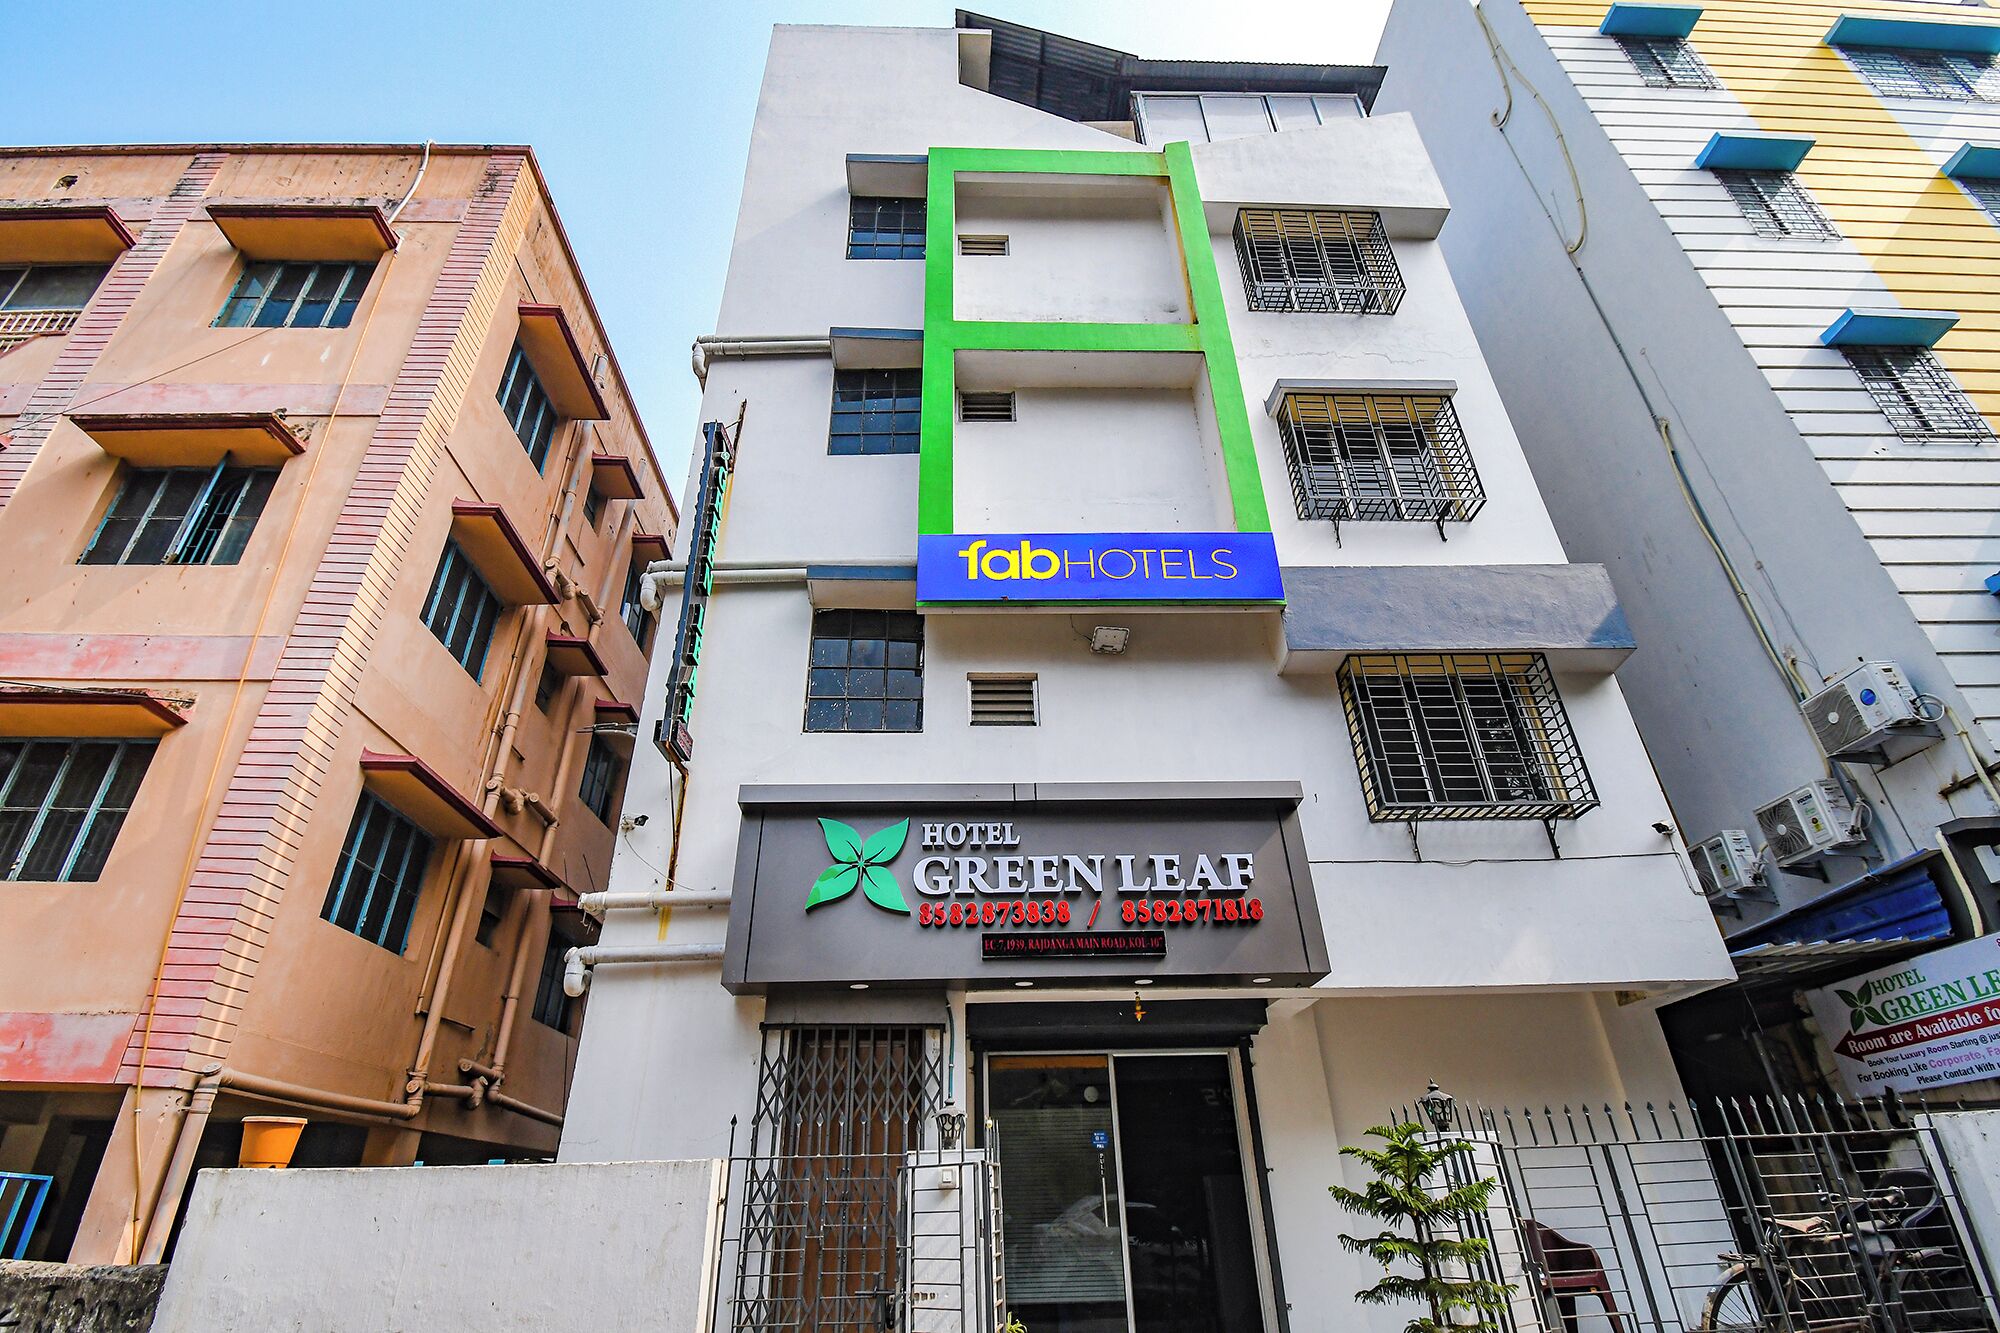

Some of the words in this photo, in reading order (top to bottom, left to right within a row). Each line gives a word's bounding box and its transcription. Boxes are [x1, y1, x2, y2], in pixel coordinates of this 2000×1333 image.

[921, 822, 1021, 848] HOTEL
[912, 854, 1105, 896] GREEN
[1115, 852, 1255, 893] LEAF
[918, 899, 1071, 927] 8582873838
[1121, 897, 1265, 924] 8582871818
[1028, 938, 1075, 953] RAJDANGA
[1076, 937, 1100, 950] MAIN
[1870, 968, 1926, 996] HOTEL
[1880, 979, 1968, 1021] GREEN
[1847, 1036, 1887, 1054] Room
[1889, 1030, 1914, 1045] are
[1916, 1011, 1983, 1039] Available
[1857, 1073, 1873, 1084] For
[1873, 1066, 1909, 1080] Booking
[1909, 1061, 1928, 1073] Like
[1928, 1049, 1986, 1069] Corporate,
[1867, 1056, 1885, 1068] Book
[1884, 1055, 1900, 1064] Your
[1900, 1049, 1926, 1061] Luxury
[1926, 1043, 1950, 1054] Room
[1949, 1037, 1979, 1050] Starting
[1916, 1072, 1943, 1085] Please
[1943, 1065, 1975, 1080] Contact
[1974, 1061, 1996, 1073] With
